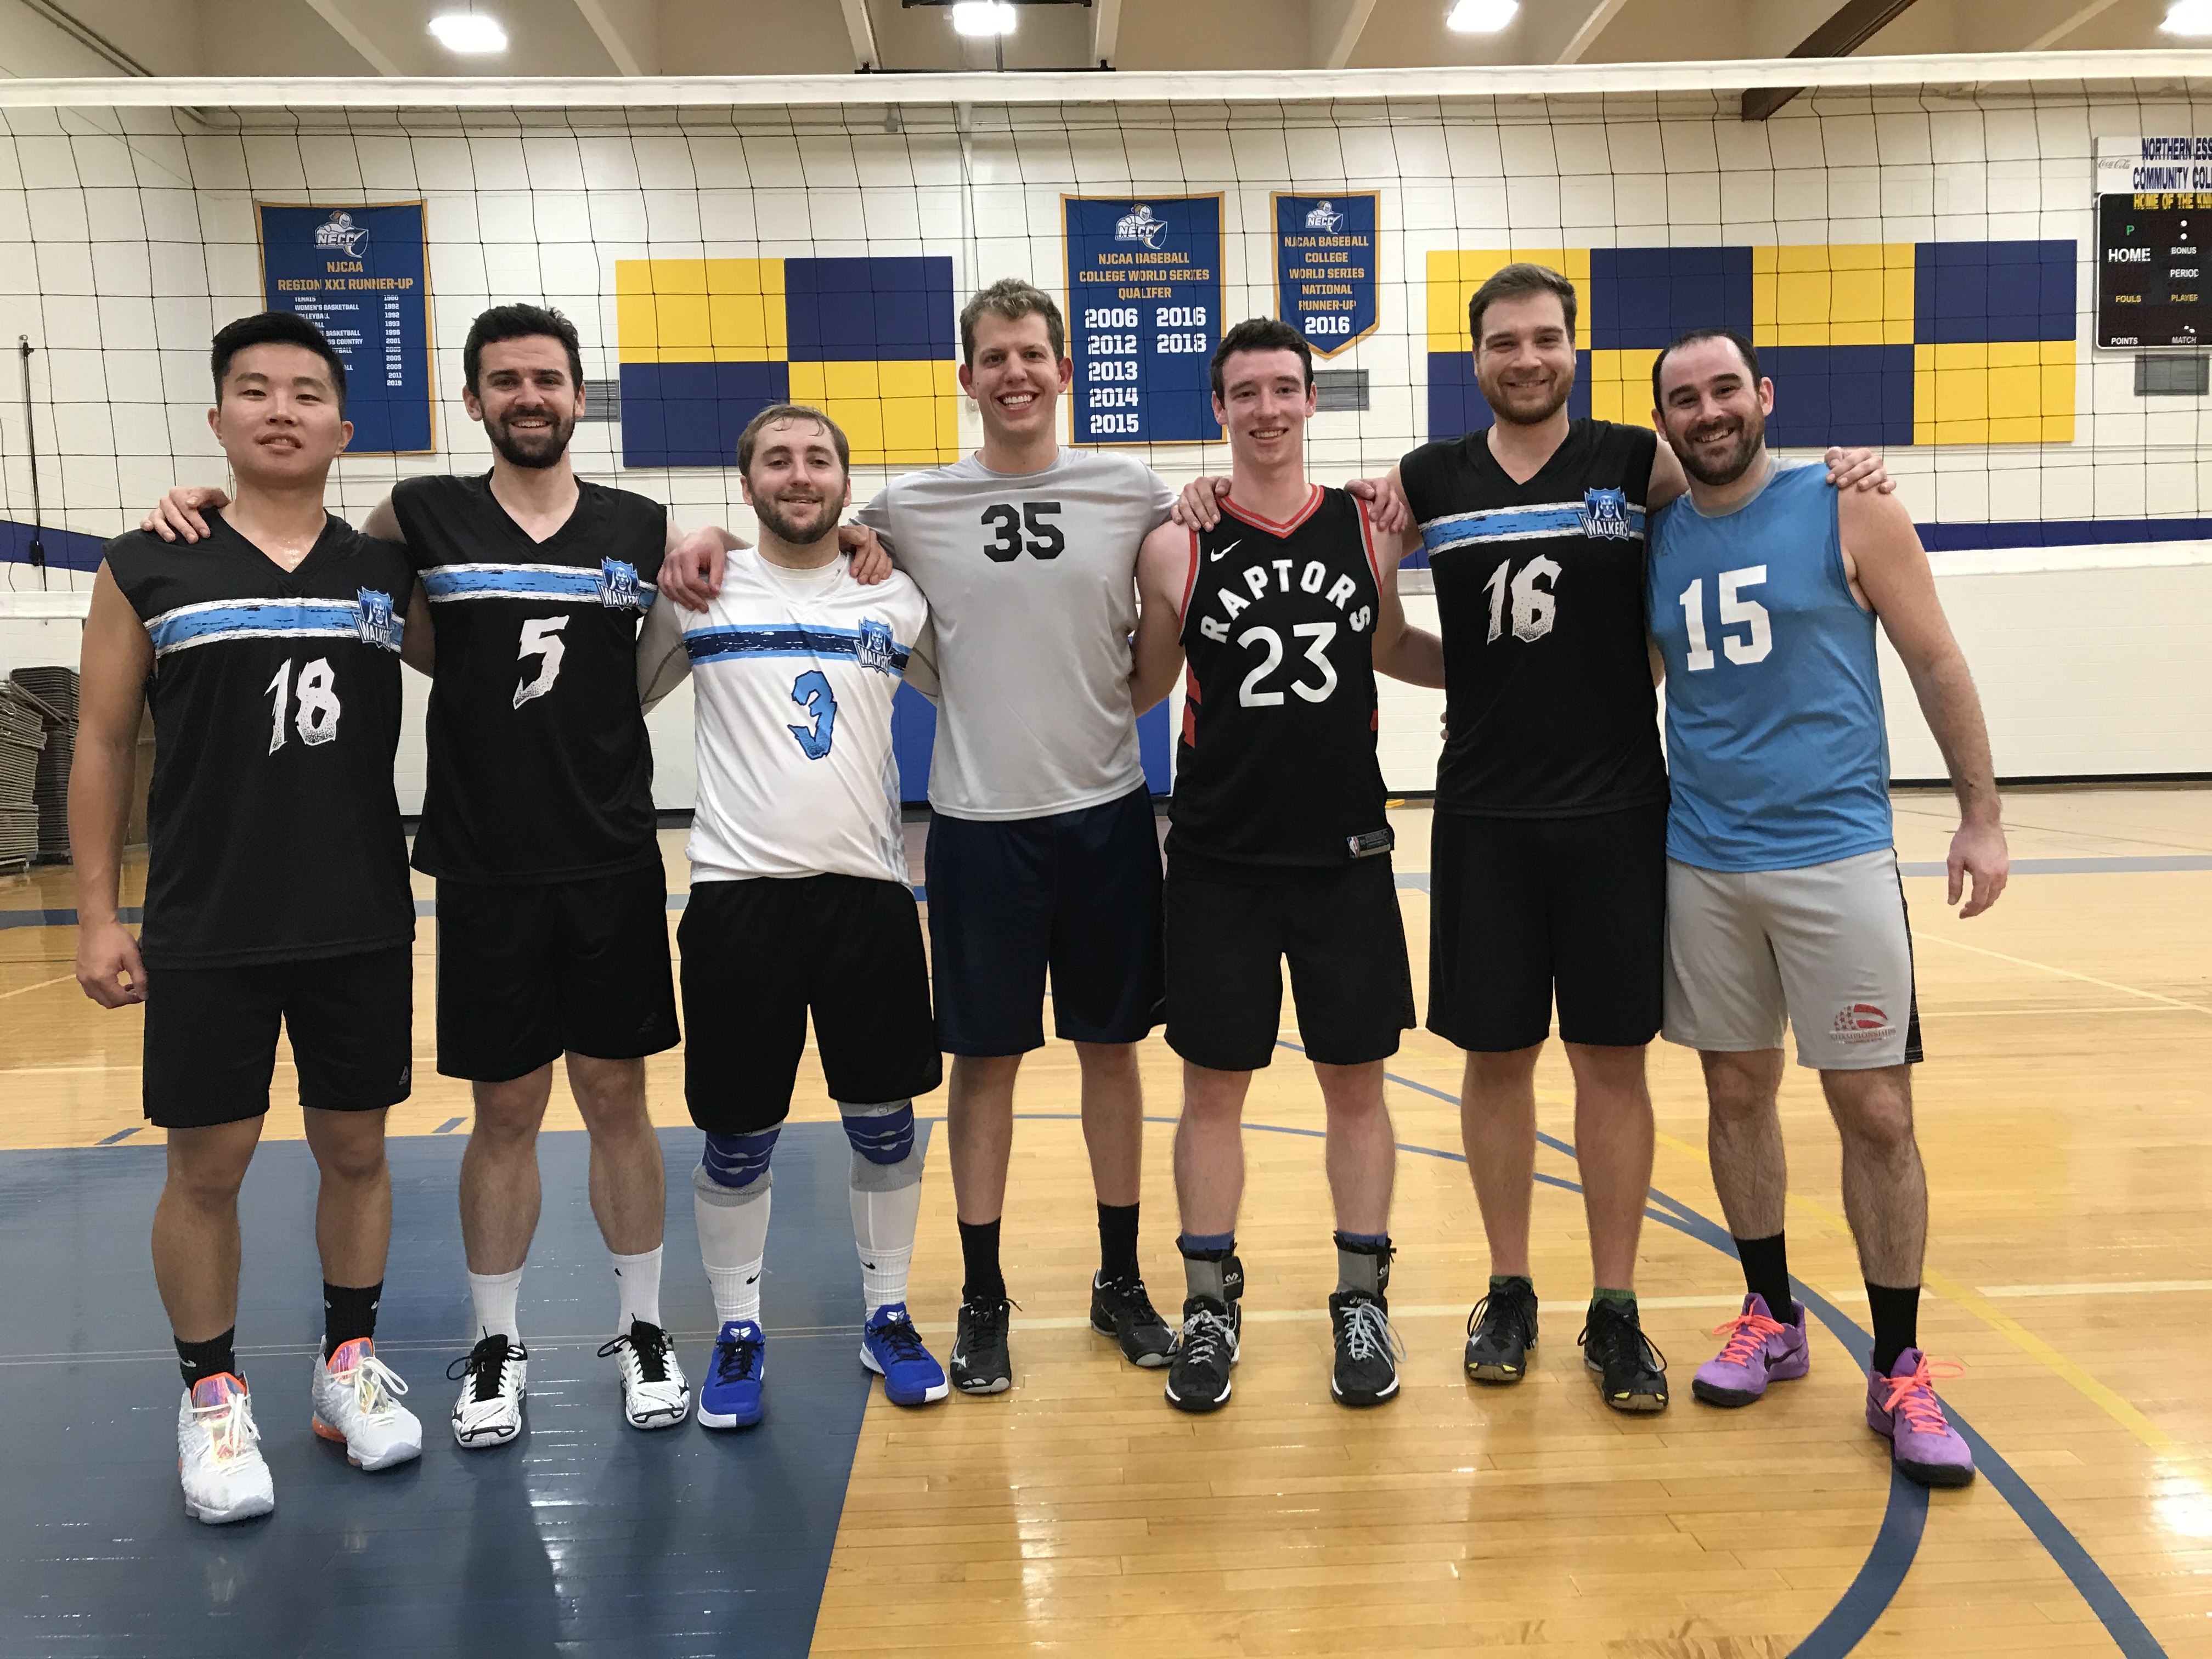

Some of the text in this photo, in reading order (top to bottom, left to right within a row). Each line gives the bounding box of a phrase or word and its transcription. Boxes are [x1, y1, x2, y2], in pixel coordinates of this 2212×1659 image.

[2142, 138, 2192, 160] NORTHERN
[2133, 166, 2212, 189] COMMUNITY COL
[2134, 193, 2159, 210] HOME
[2162, 193, 2174, 210] OF
[2177, 193, 2193, 210] THE
[1308, 217, 1334, 225] NECC
[1119, 225, 1154, 238] NECC
[2126, 225, 2135, 235] P
[318, 234, 355, 246] NECC
[1284, 236, 1369, 247] NJCAA BASEBALL
[1098, 252, 1189, 264] NJCAA BASEBALL
[1305, 252, 1348, 263] COLLEGE
[2108, 248, 2151, 263] HOME
[326, 261, 363, 272] NJCAA
[1289, 268, 1364, 279] WORLD SERIES
[278, 278, 413, 290] REGION XXI RUNNER-UP
[1079, 269, 1210, 282] COLLEGE WORLD SERIES
[1118, 287, 1171, 300] QUALIFER
[1302, 284, 1352, 295] NATIONAL
[1299, 300, 1356, 311] RUNNER-UP
[2115, 295, 2142, 303] FOULS
[1085, 307, 1206, 328] 2006 2016
[1305, 316, 1350, 334] 2016
[1088, 333, 1206, 355] 2012 2018
[1088, 361, 1138, 381] 2013
[1089, 387, 1138, 408] 2014
[1090, 414, 1139, 433] 2015
[980, 501, 1065, 563] 35
[1583, 517, 1629, 537] WALKERS
[1200, 559, 1370, 644] RAPTORS
[1481, 554, 1562, 646] 16
[1679, 565, 1773, 672] 15
[512, 614, 570, 710] 5
[1237, 622, 1338, 708] 23
[263, 657, 341, 757] 18
[787, 670, 838, 760] 3
